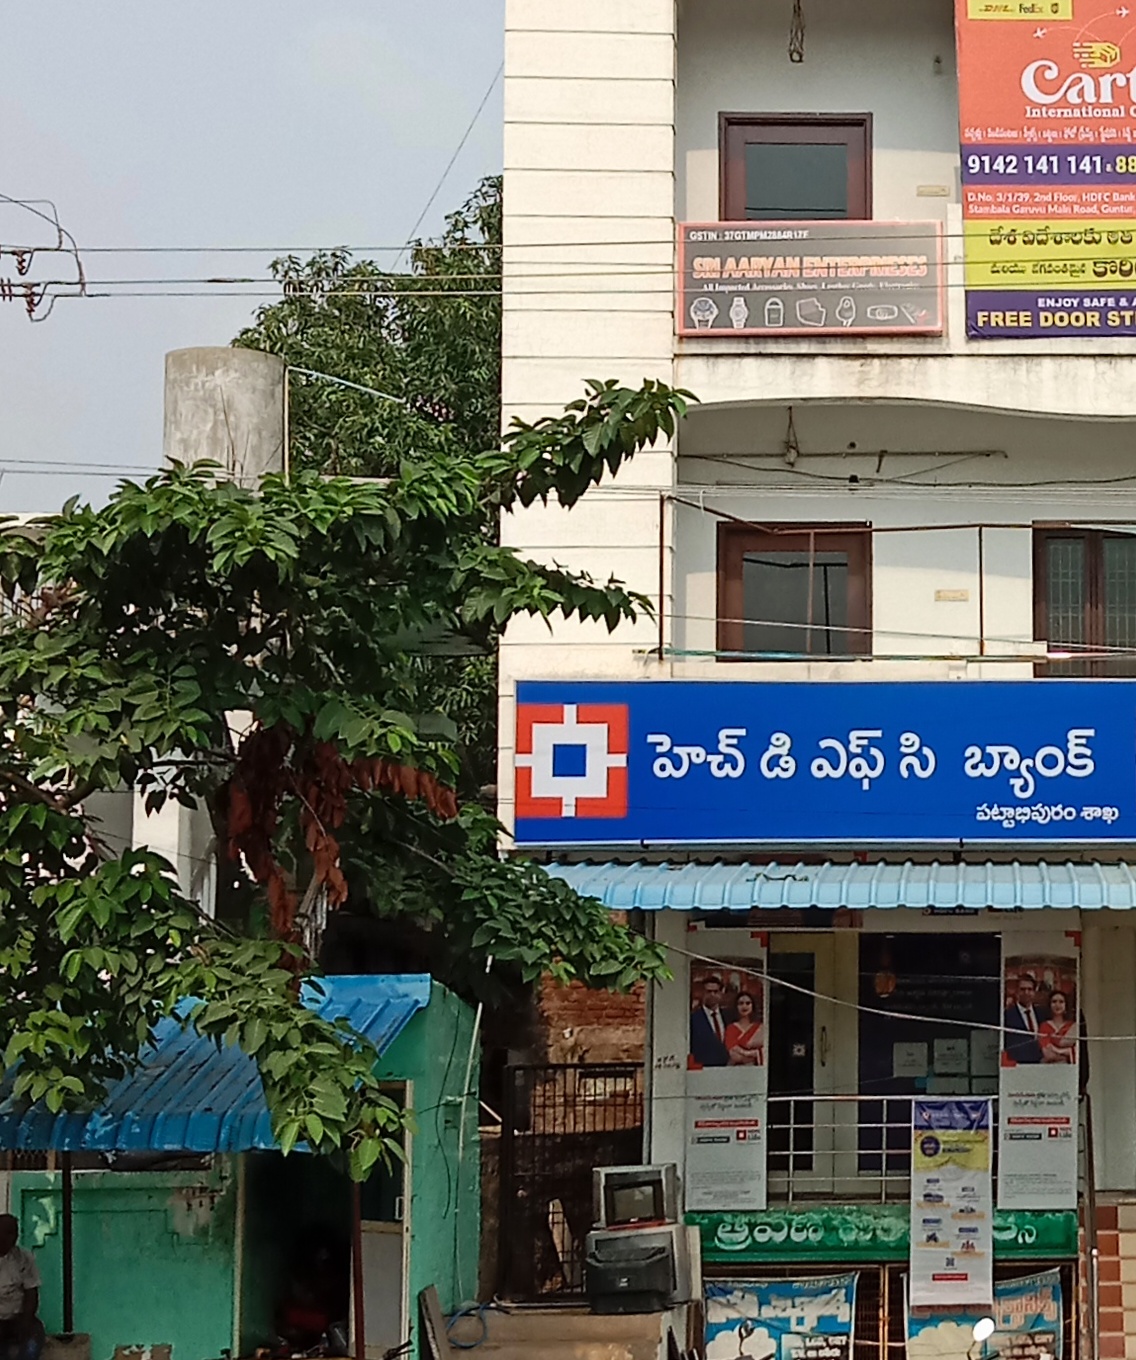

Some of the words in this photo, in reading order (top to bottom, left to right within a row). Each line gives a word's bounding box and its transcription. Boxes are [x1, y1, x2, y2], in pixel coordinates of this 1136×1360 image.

[1024, 105, 1125, 118] International
[967, 155, 1017, 174] 9142
[1024, 155, 1060, 173] 141
[1067, 155, 1101, 173] 141
[1033, 191, 1053, 203] 2nd
[1113, 191, 1136, 202] Bank
[1047, 203, 1072, 214] Main
[693, 256, 721, 279] SRI
[1038, 297, 1079, 308] ENJOY
[1083, 297, 1116, 307] SAFE
[1119, 298, 1128, 307] &
[977, 310, 1032, 327] FREE
[1039, 310, 1101, 327] DOOR
[646, 728, 747, 779] హెచ్
[760, 731, 797, 779] డి
[810, 729, 885, 791] ఎఫ్
[899, 731, 936, 779] సి
[964, 728, 1096, 799] బ్యాంక్
[975, 802, 1077, 828] పట్టాభిపురం
[1080, 804, 1120, 824] శాఖ
